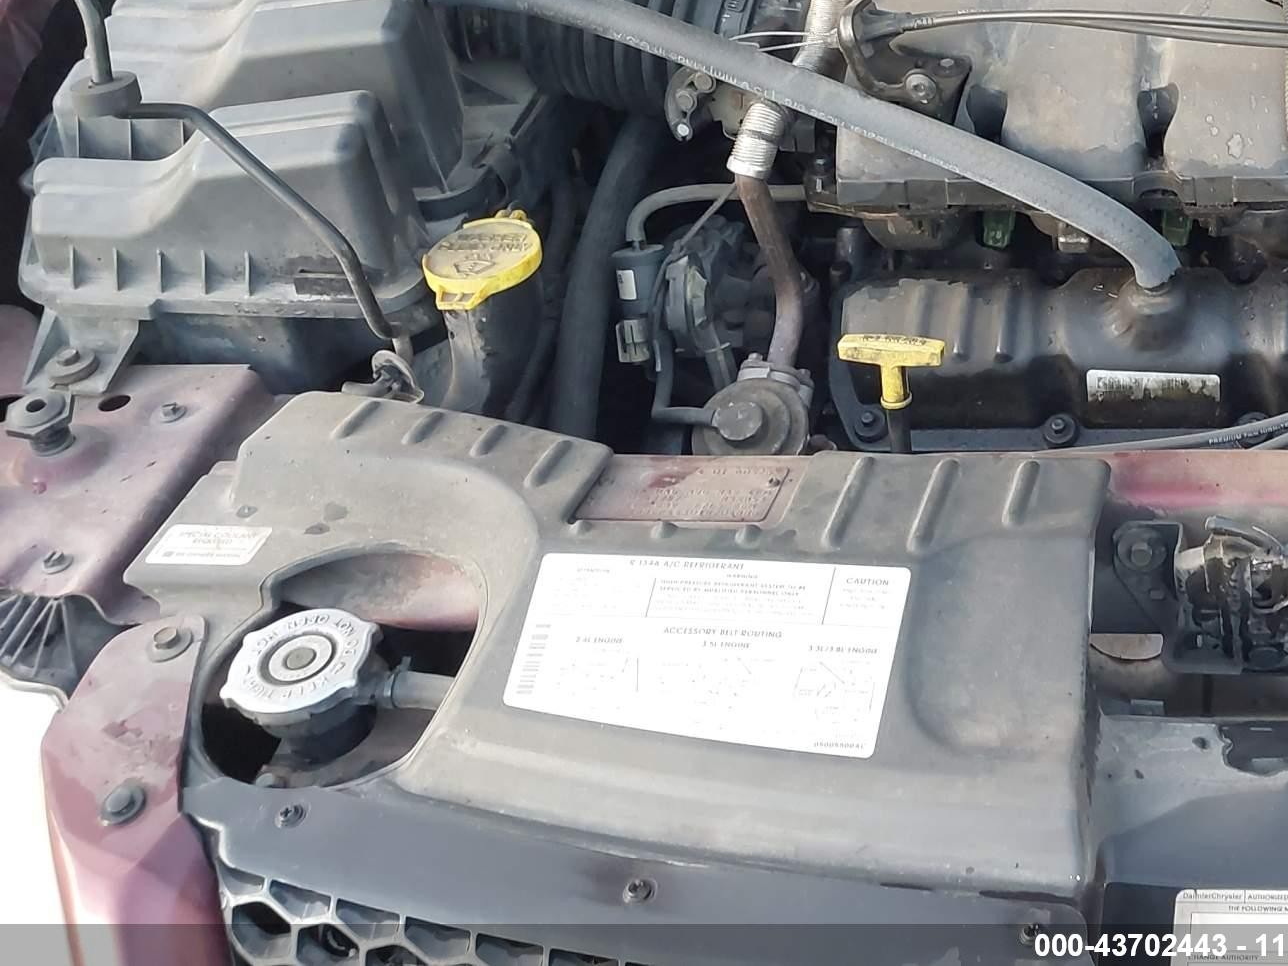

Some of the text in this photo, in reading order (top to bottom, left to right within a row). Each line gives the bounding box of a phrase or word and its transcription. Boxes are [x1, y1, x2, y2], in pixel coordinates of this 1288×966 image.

[663, 560, 681, 569] A/C
[683, 561, 745, 571] REFRIGERANT
[845, 577, 890, 586] CAUTION
[664, 626, 783, 639] ACCESSORY BELT ROUTING
[719, 641, 751, 649] ENGINE
[846, 646, 879, 655] ENGINE
[1182, 892, 1242, 902] DaimlerChrysler
[1247, 893, 1288, 902] AUTHORIZED
[1228, 905, 1241, 913] THE
[1242, 905, 1283, 913] FOLLOWING
